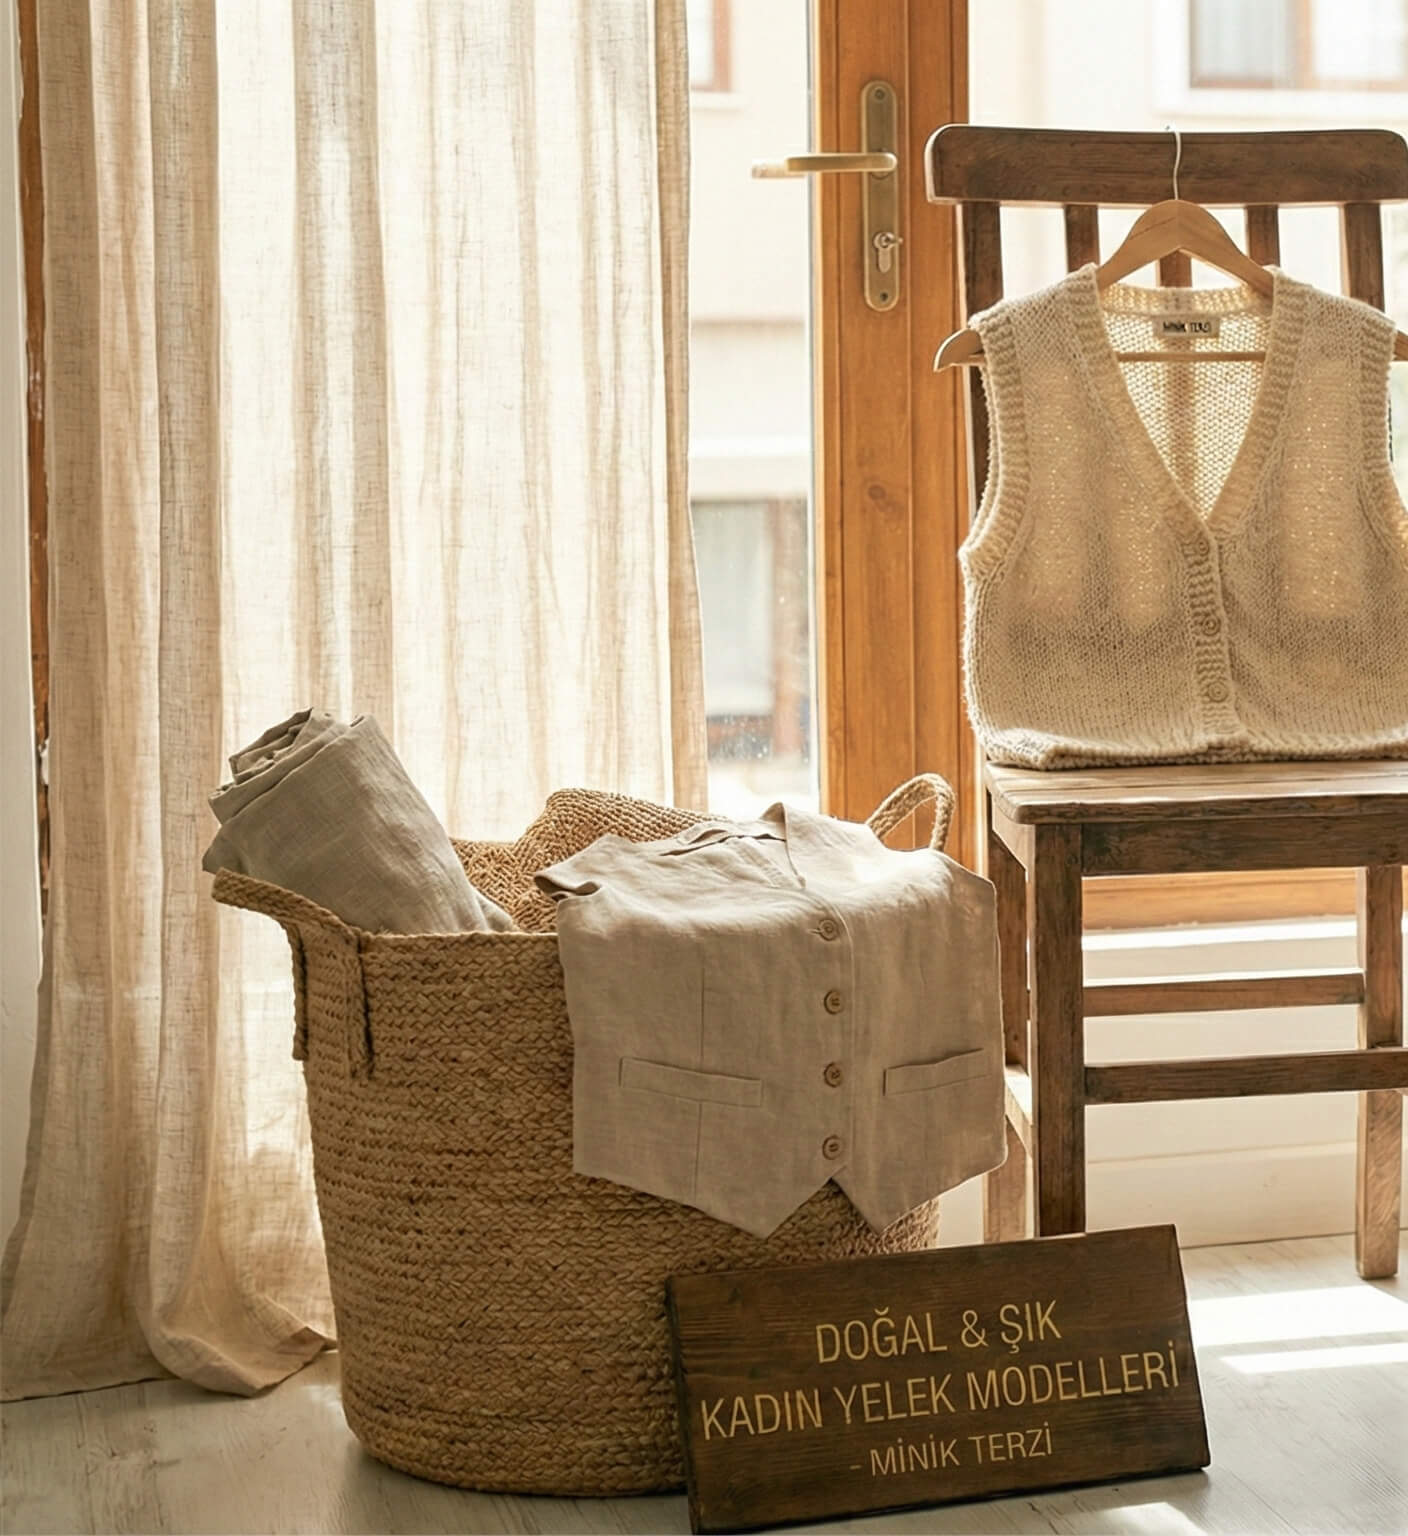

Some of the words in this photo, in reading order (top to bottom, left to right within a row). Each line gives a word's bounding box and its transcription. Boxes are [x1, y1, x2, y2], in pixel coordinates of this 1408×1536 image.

[815, 1306, 948, 1364] DOĞAL
[960, 1309, 989, 1348] &
[999, 1299, 1062, 1354] ŞIK
[701, 1388, 823, 1441] KADIN
[833, 1373, 956, 1425] YELEK
[966, 1340, 1179, 1411] MODELLERİ
[869, 1434, 961, 1477] MİNİK
[967, 1421, 1053, 1465] TERZİ
